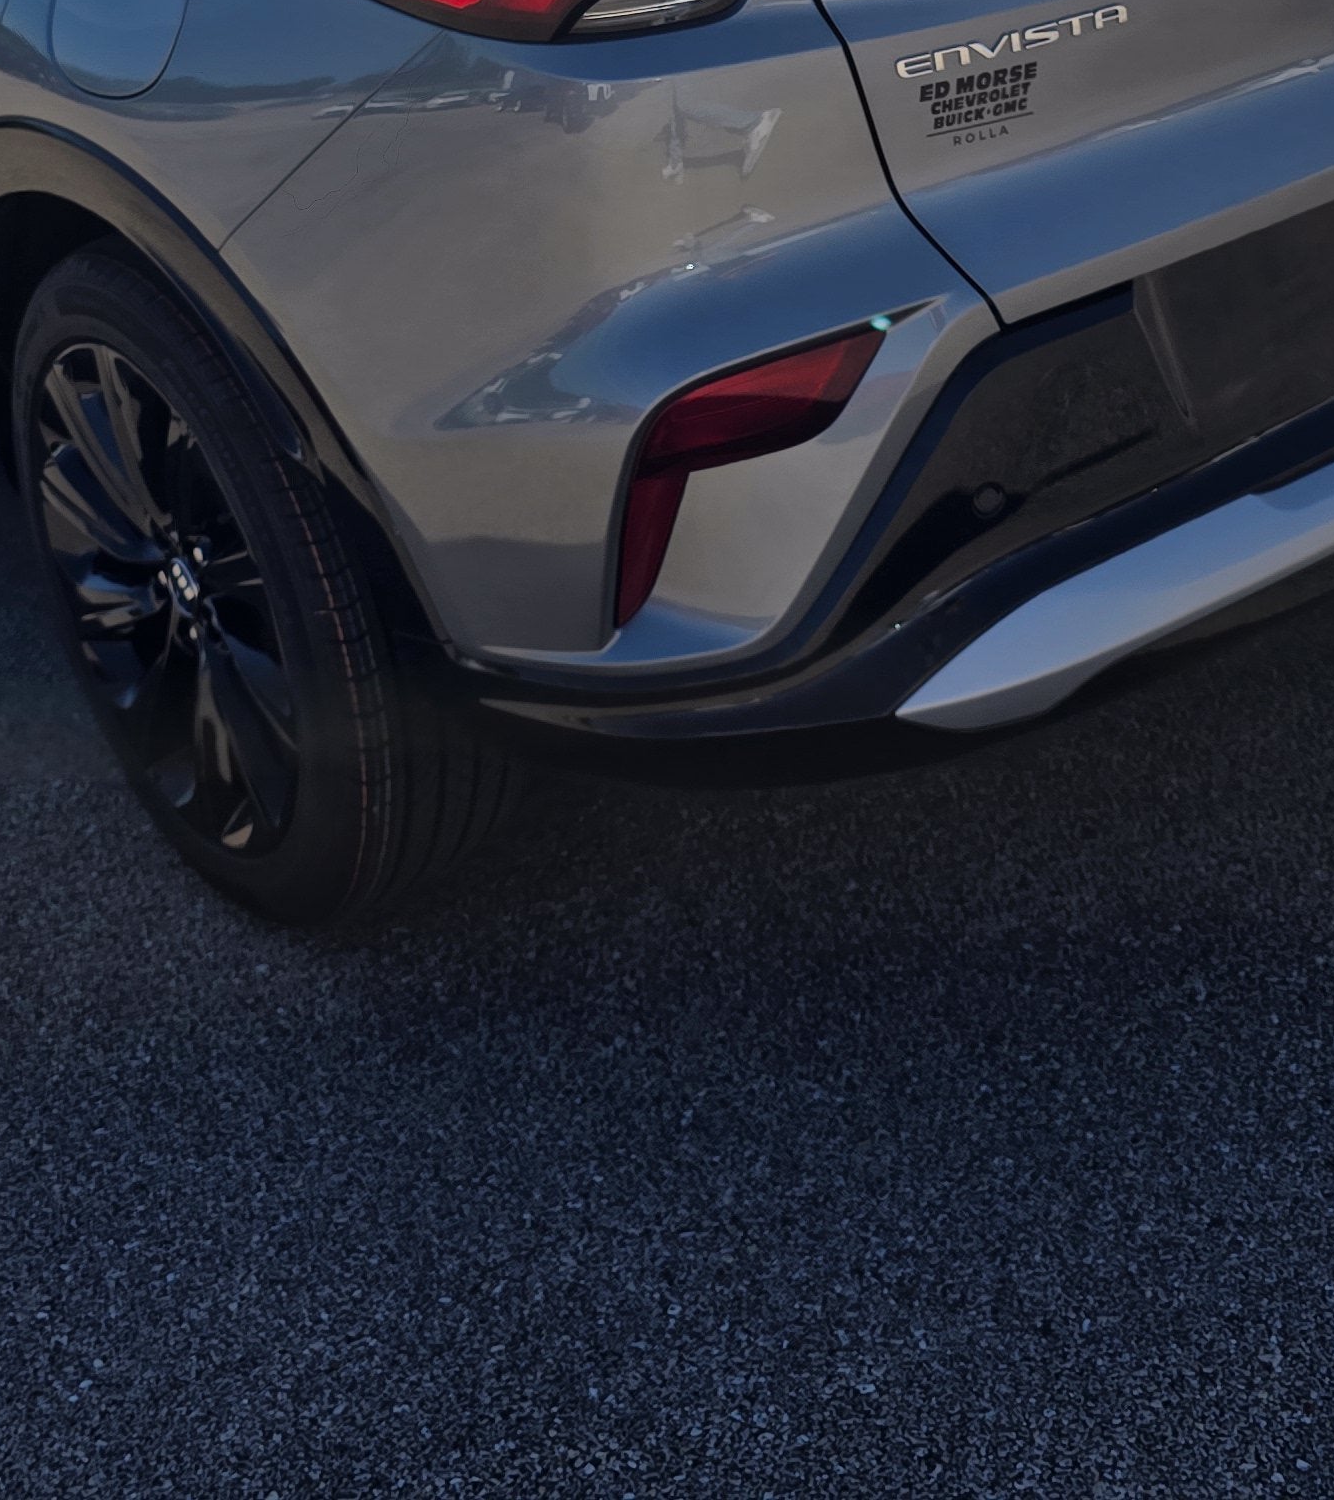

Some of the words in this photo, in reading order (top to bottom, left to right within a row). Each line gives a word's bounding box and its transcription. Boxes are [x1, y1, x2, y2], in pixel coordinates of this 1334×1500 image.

[895, 4, 1128, 79] ENVISTA
[919, 80, 950, 102] ED
[955, 61, 1038, 96] MORSE
[930, 81, 1031, 115] CHEVROLET
[952, 124, 1009, 147] ROLLA
